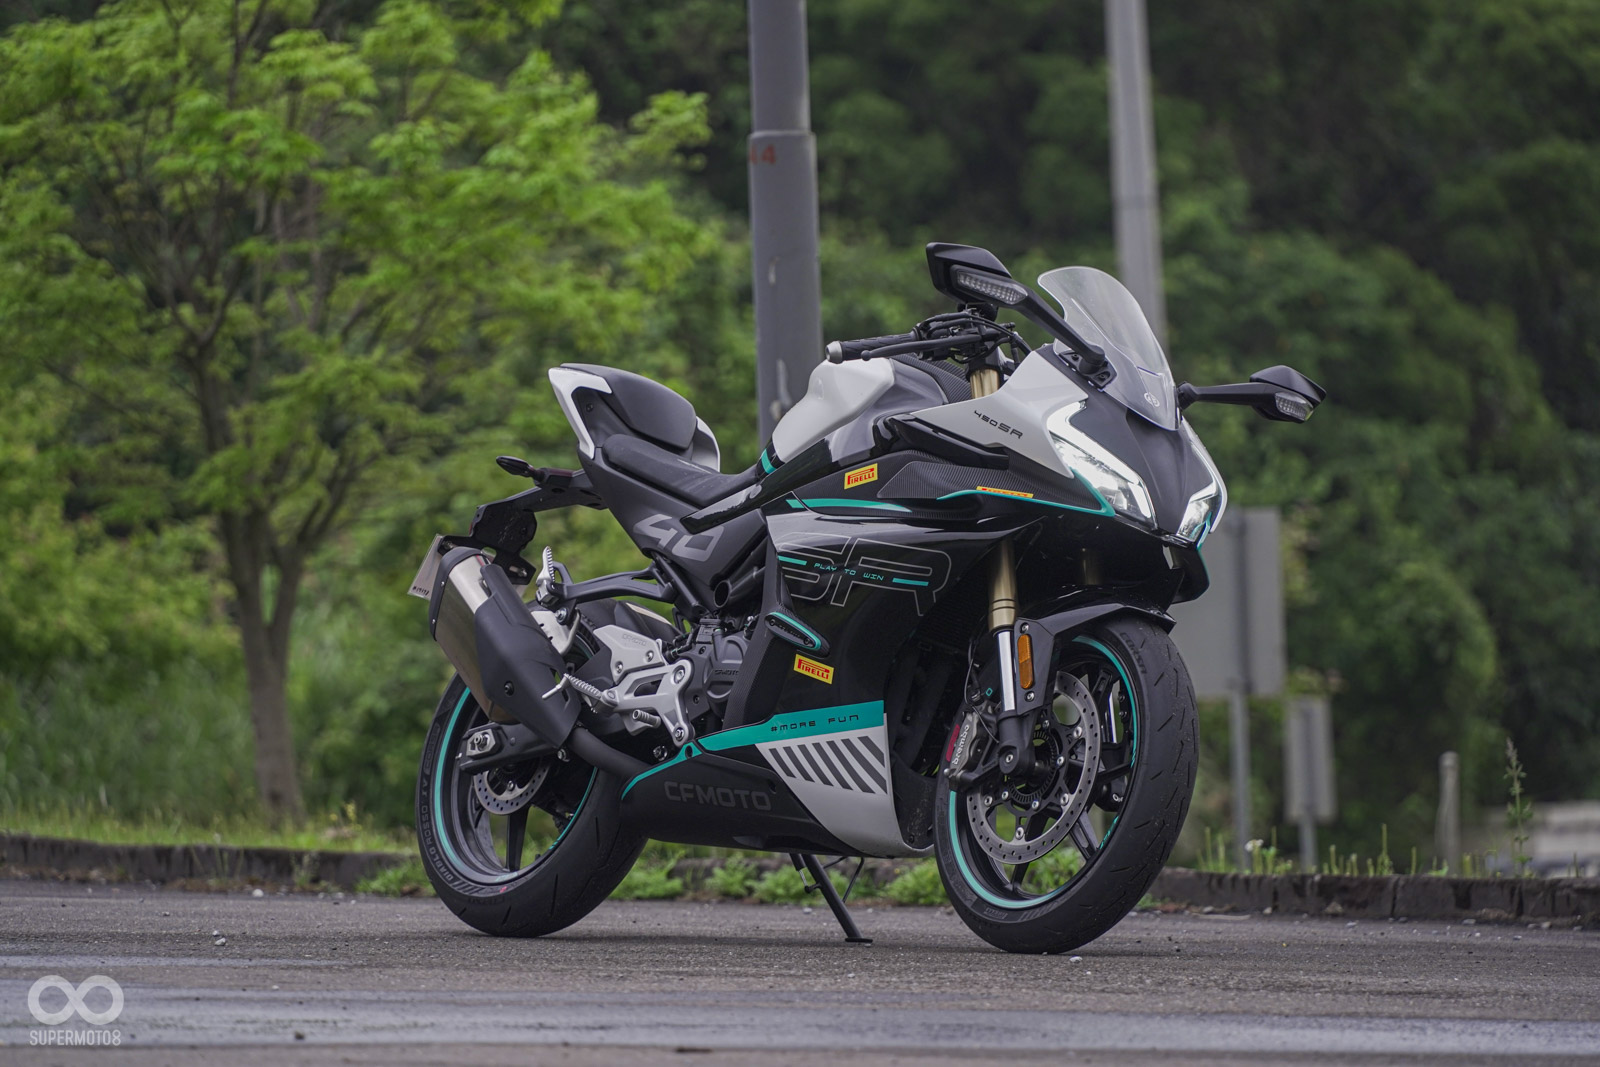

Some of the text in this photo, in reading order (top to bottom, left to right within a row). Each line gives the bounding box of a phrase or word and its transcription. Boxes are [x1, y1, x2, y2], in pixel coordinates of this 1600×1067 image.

[974, 410, 1023, 439] 450SR
[847, 467, 875, 487] PIRELLI
[814, 562, 885, 581] PLAY TO WIN
[798, 658, 830, 680] PIRELLI
[771, 714, 859, 732] #MORE FUN
[952, 724, 970, 765] brembo
[664, 781, 772, 811] CFMOTO
[421, 805, 433, 846] ROSSO
[430, 846, 453, 883] DIABLO
